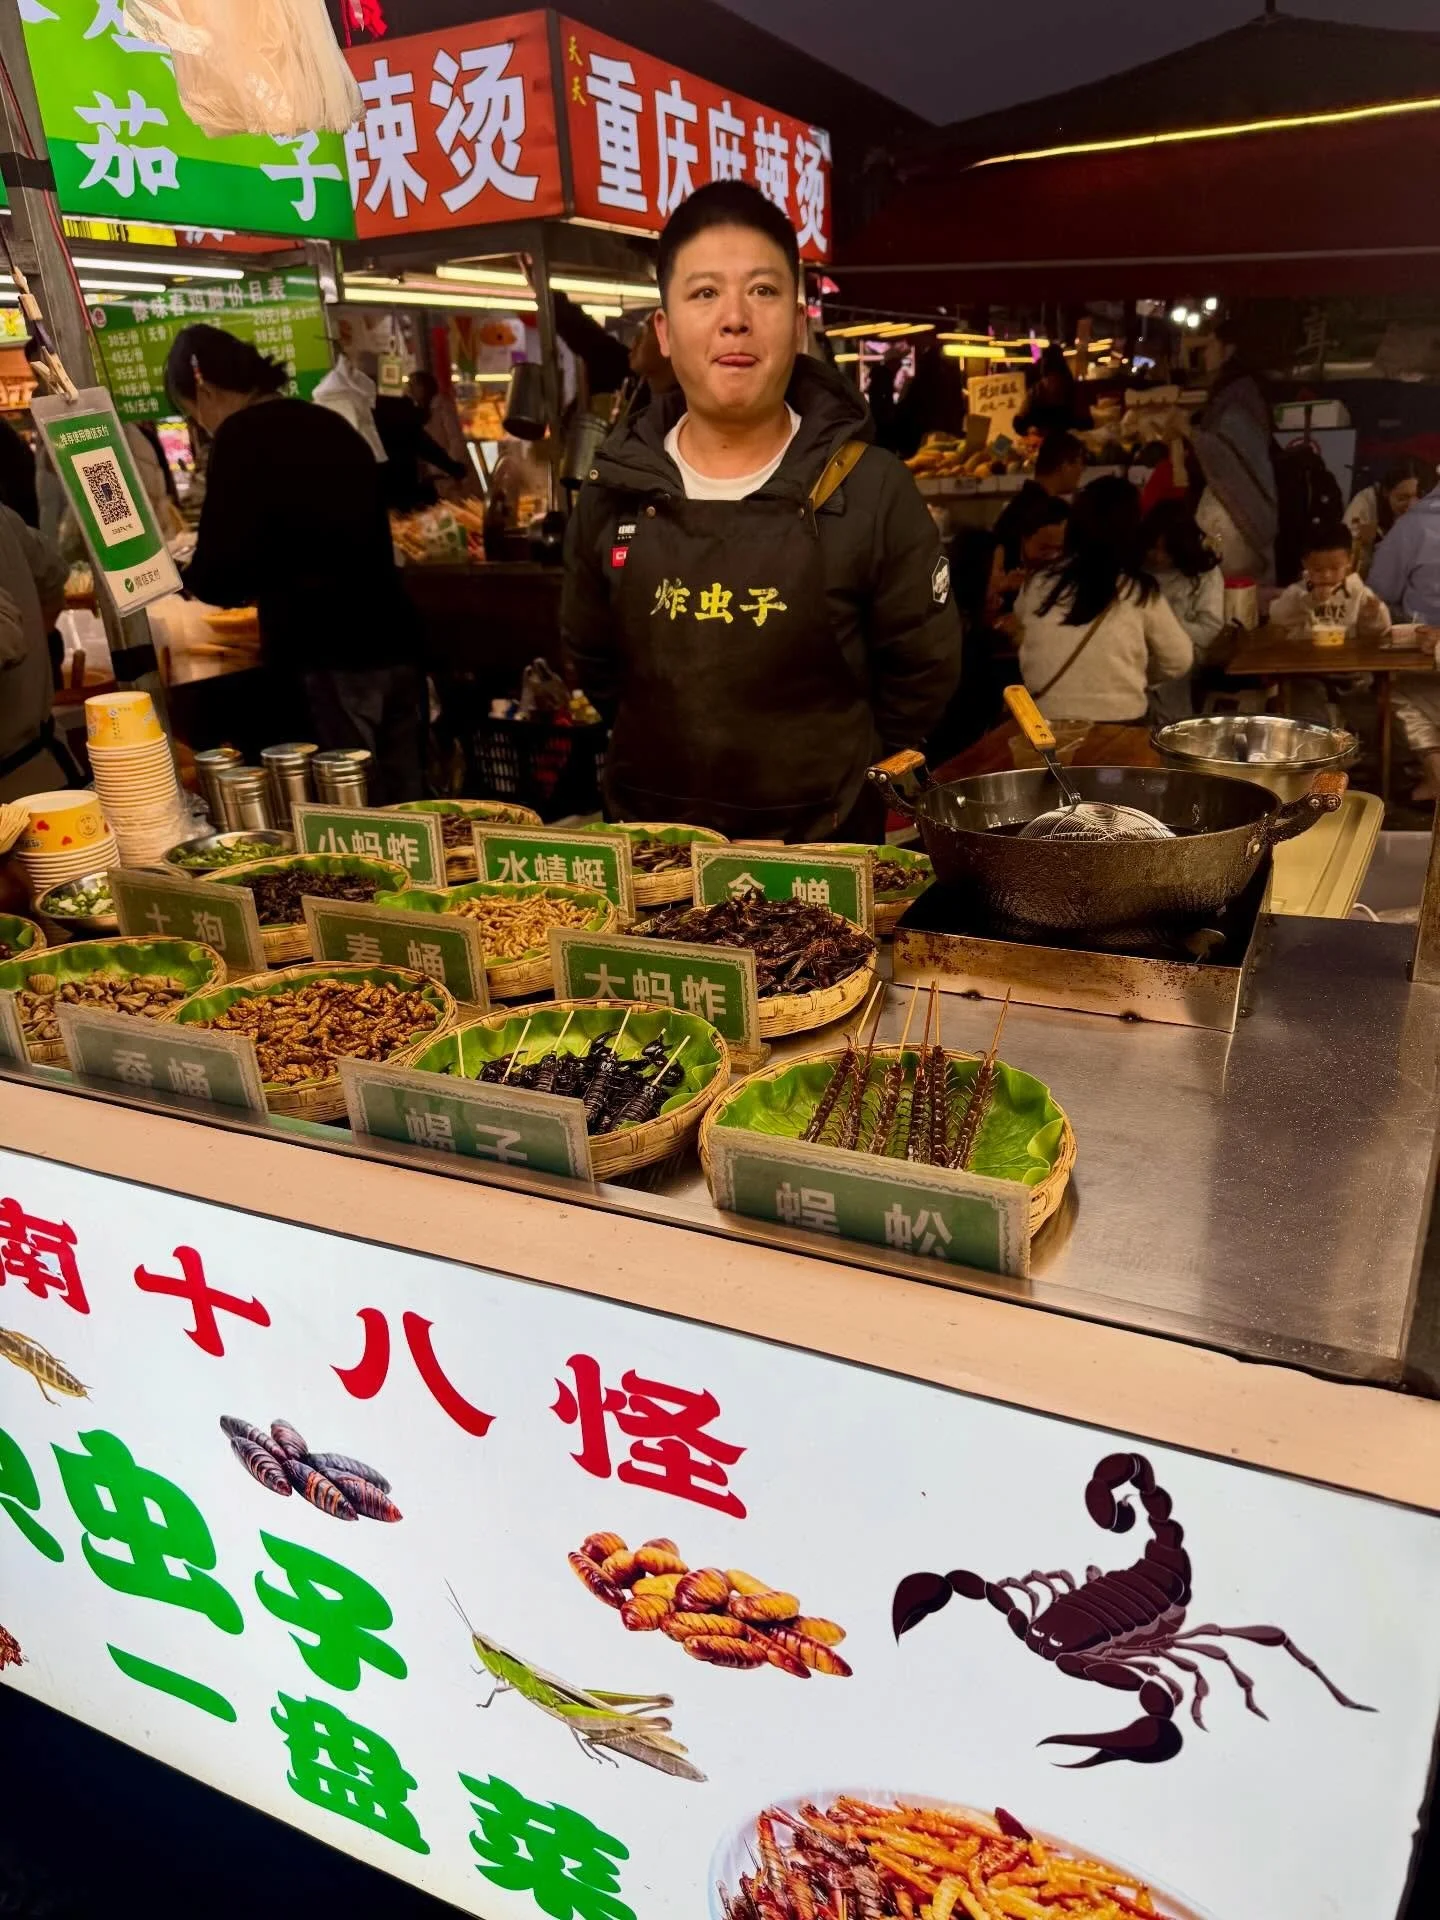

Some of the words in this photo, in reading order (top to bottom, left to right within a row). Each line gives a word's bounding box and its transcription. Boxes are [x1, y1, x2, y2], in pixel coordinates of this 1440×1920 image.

[568, 35, 588, 107] 天天
[74, 89, 344, 221] 茄子
[343, 41, 540, 219] 辣烫
[586, 52, 828, 254] 重庆麻辣烫
[134, 568, 161, 589] 微信支付
[650, 577, 788, 627] 炸虫子
[318, 827, 420, 868] 小蚂蚱
[497, 850, 608, 894] 水蜻蜓
[584, 963, 726, 1022] 大蚂蚱
[776, 1181, 953, 1257] 蜈蚣
[0, 1197, 748, 1519] 南十八怪
[0, 1428, 408, 1691] 虫子
[106, 1643, 638, 1920] 一盘菜
